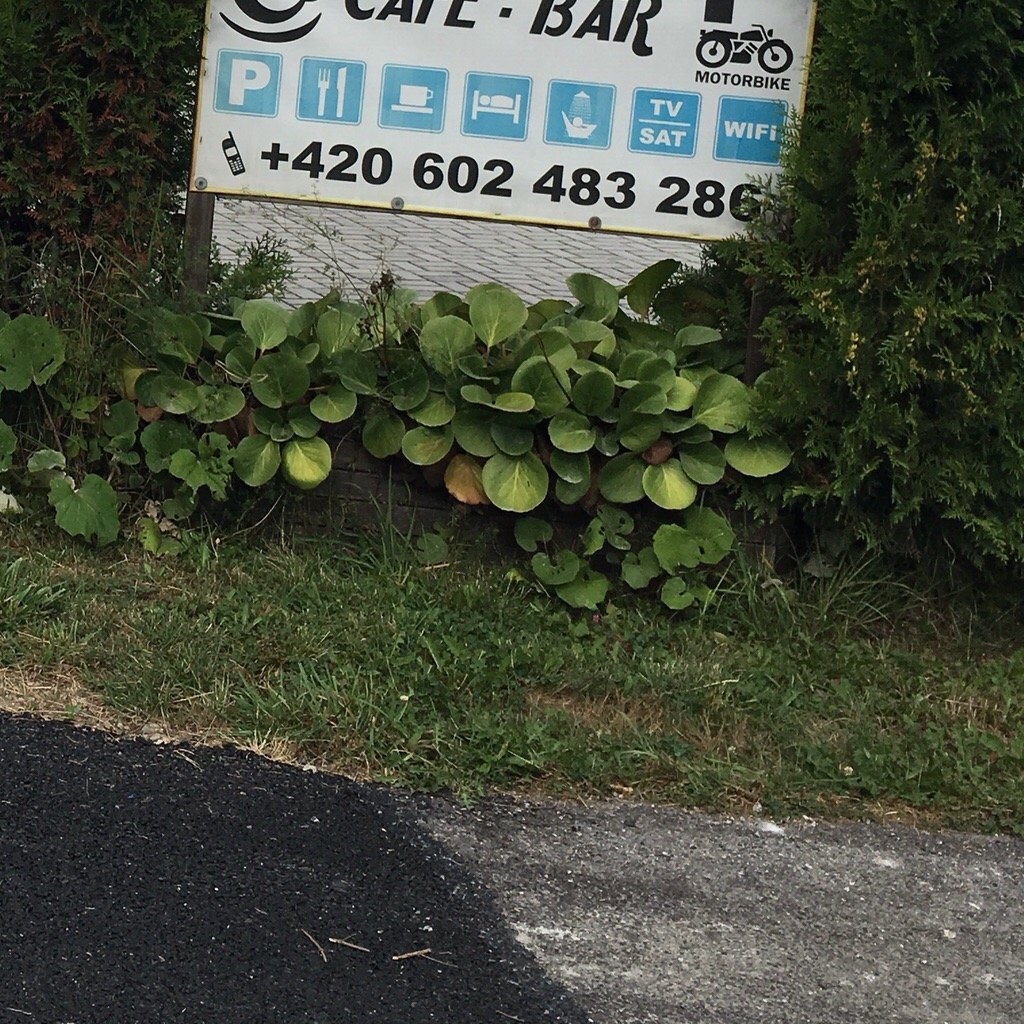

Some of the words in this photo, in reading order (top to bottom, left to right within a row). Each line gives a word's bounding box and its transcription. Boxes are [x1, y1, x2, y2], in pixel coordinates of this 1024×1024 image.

[229, 59, 272, 105] P
[693, 69, 791, 92] MOTORBIKE
[649, 97, 686, 117] TV
[638, 127, 687, 148] SAT
[261, 141, 394, 185] +420
[413, 155, 514, 198] 602
[532, 165, 637, 210] 483
[657, 176, 762, 222] 286
